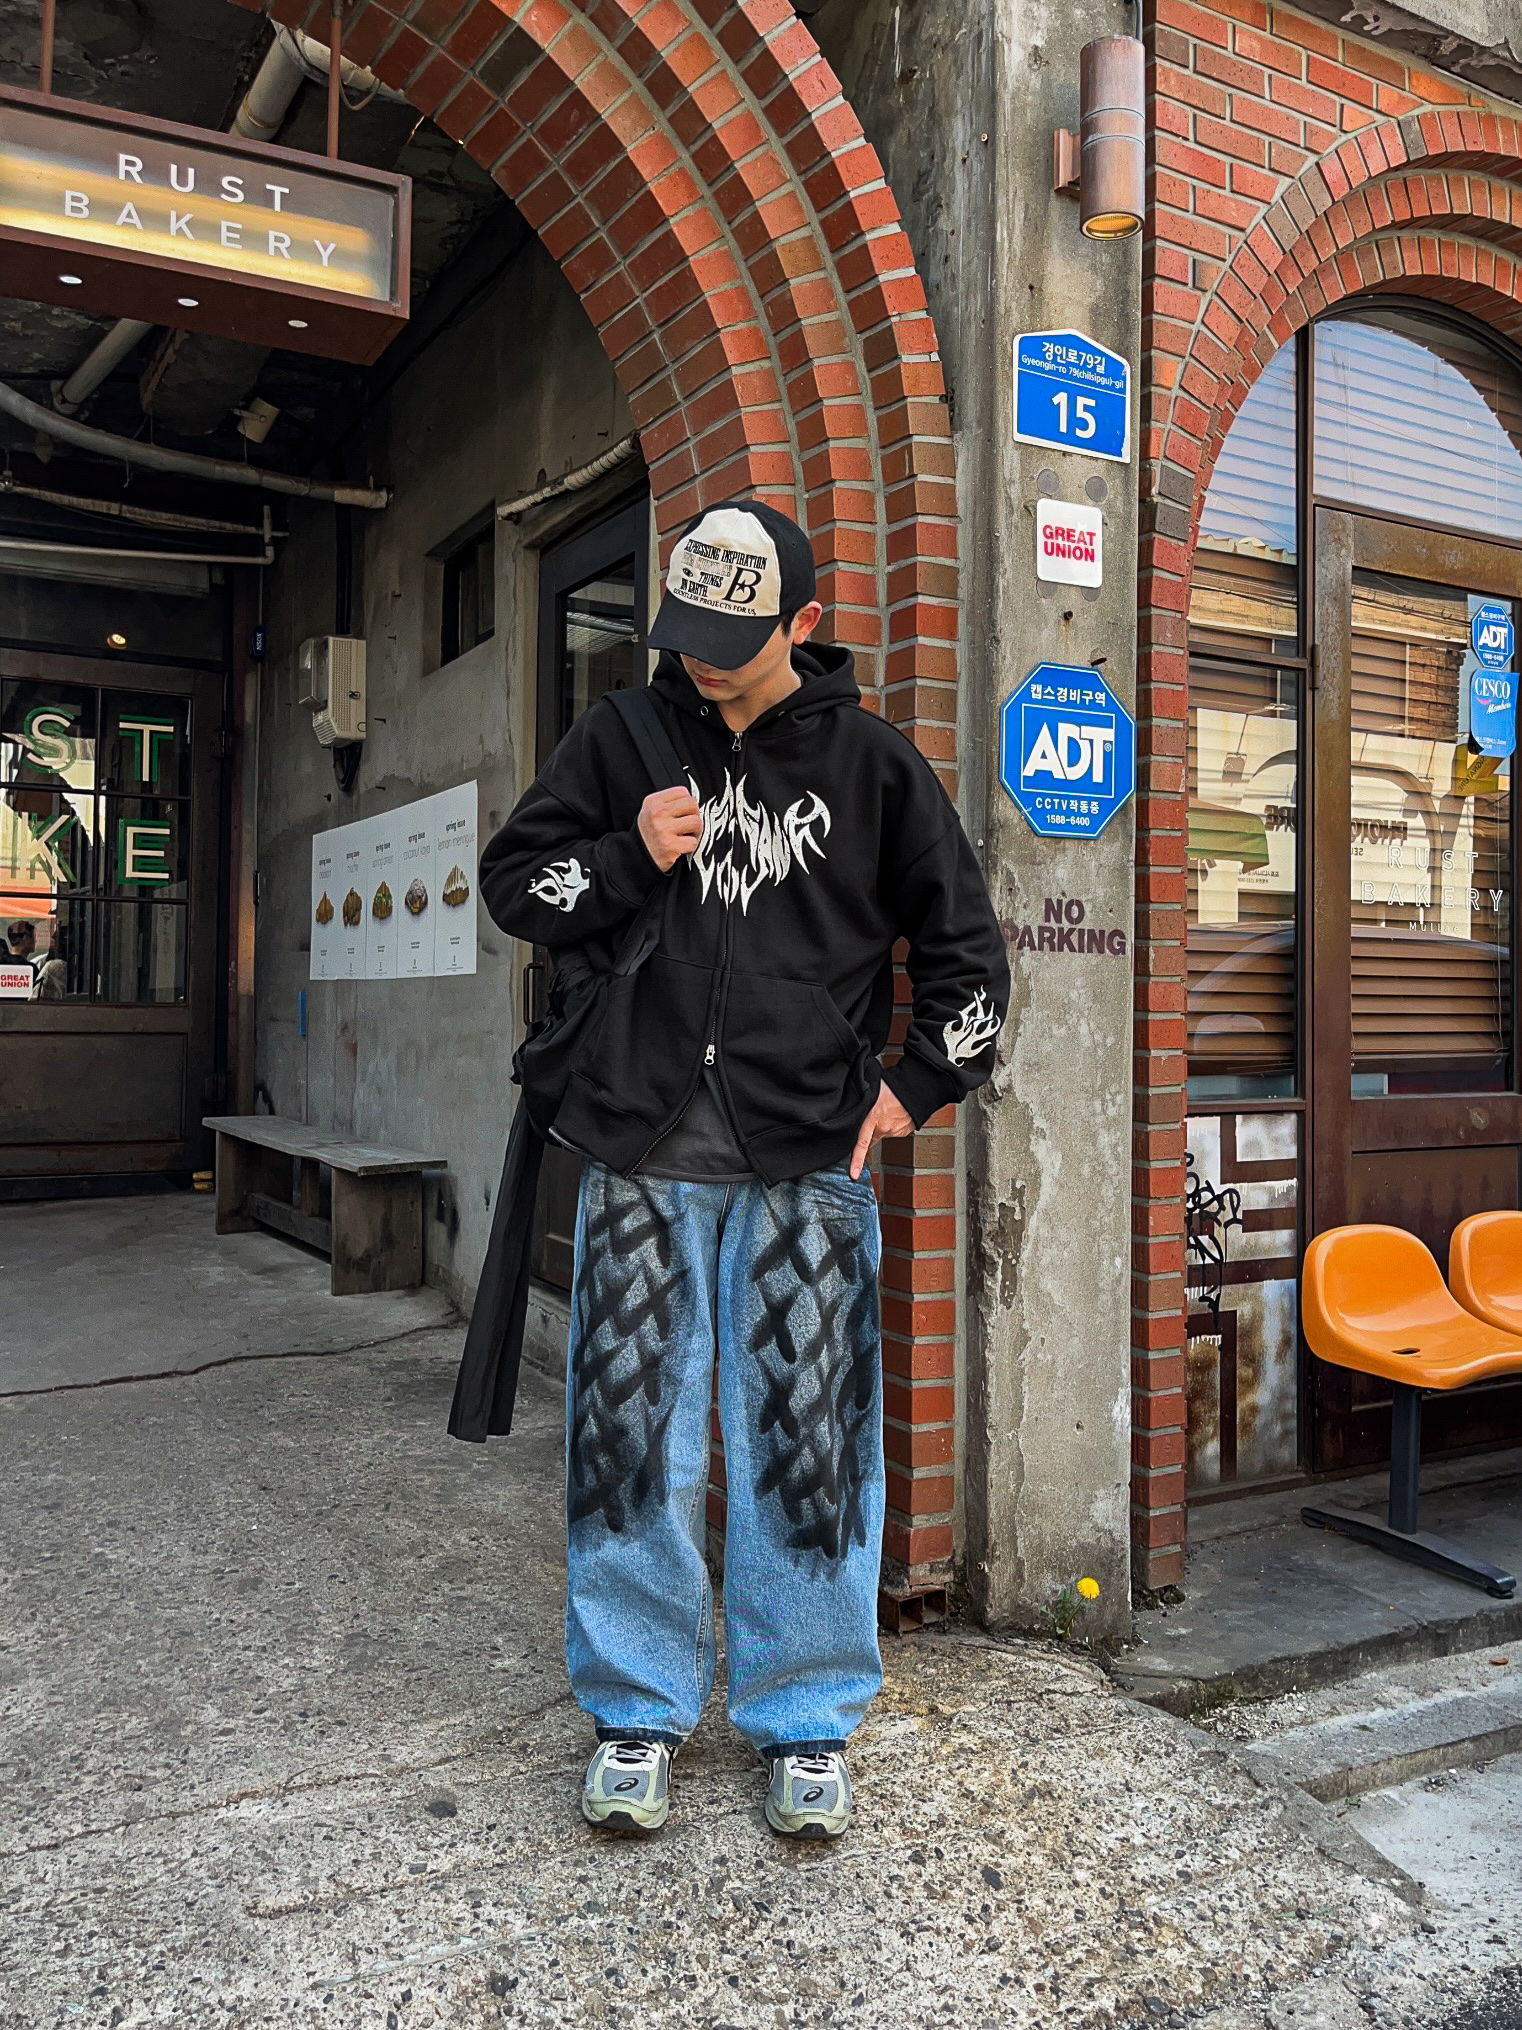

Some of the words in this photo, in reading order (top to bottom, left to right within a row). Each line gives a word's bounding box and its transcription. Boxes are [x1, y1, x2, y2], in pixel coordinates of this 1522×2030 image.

[118, 153, 289, 212] RUST
[64, 190, 336, 266] BAKERY
[1042, 342, 1105, 374] 경인로79길
[1022, 355, 1067, 374] Gyeongin-ro
[1069, 367, 1124, 389] 79(chilsipgu)-gil
[1052, 391, 1096, 439] 15
[1043, 524, 1096, 546] GREAT
[721, 549, 768, 570] INSPIRATION
[1043, 541, 1095, 563] UNION
[688, 580, 708, 598] EARTH
[698, 572, 724, 588] THINGS
[722, 566, 762, 604] B
[699, 597, 732, 611] PROJECTS
[733, 605, 747, 614] FOR
[1479, 625, 1508, 650] ADT
[1030, 684, 1106, 707] 캡스경비구역
[1475, 677, 1511, 700] CESCO
[1023, 722, 1114, 783] ADT
[1035, 797, 1100, 814] CCTV작동중
[1046, 814, 1090, 826] 1588-6400
[1388, 845, 1479, 874] RUST
[1361, 880, 1504, 912] BAKERY
[1044, 898, 1085, 925] NO
